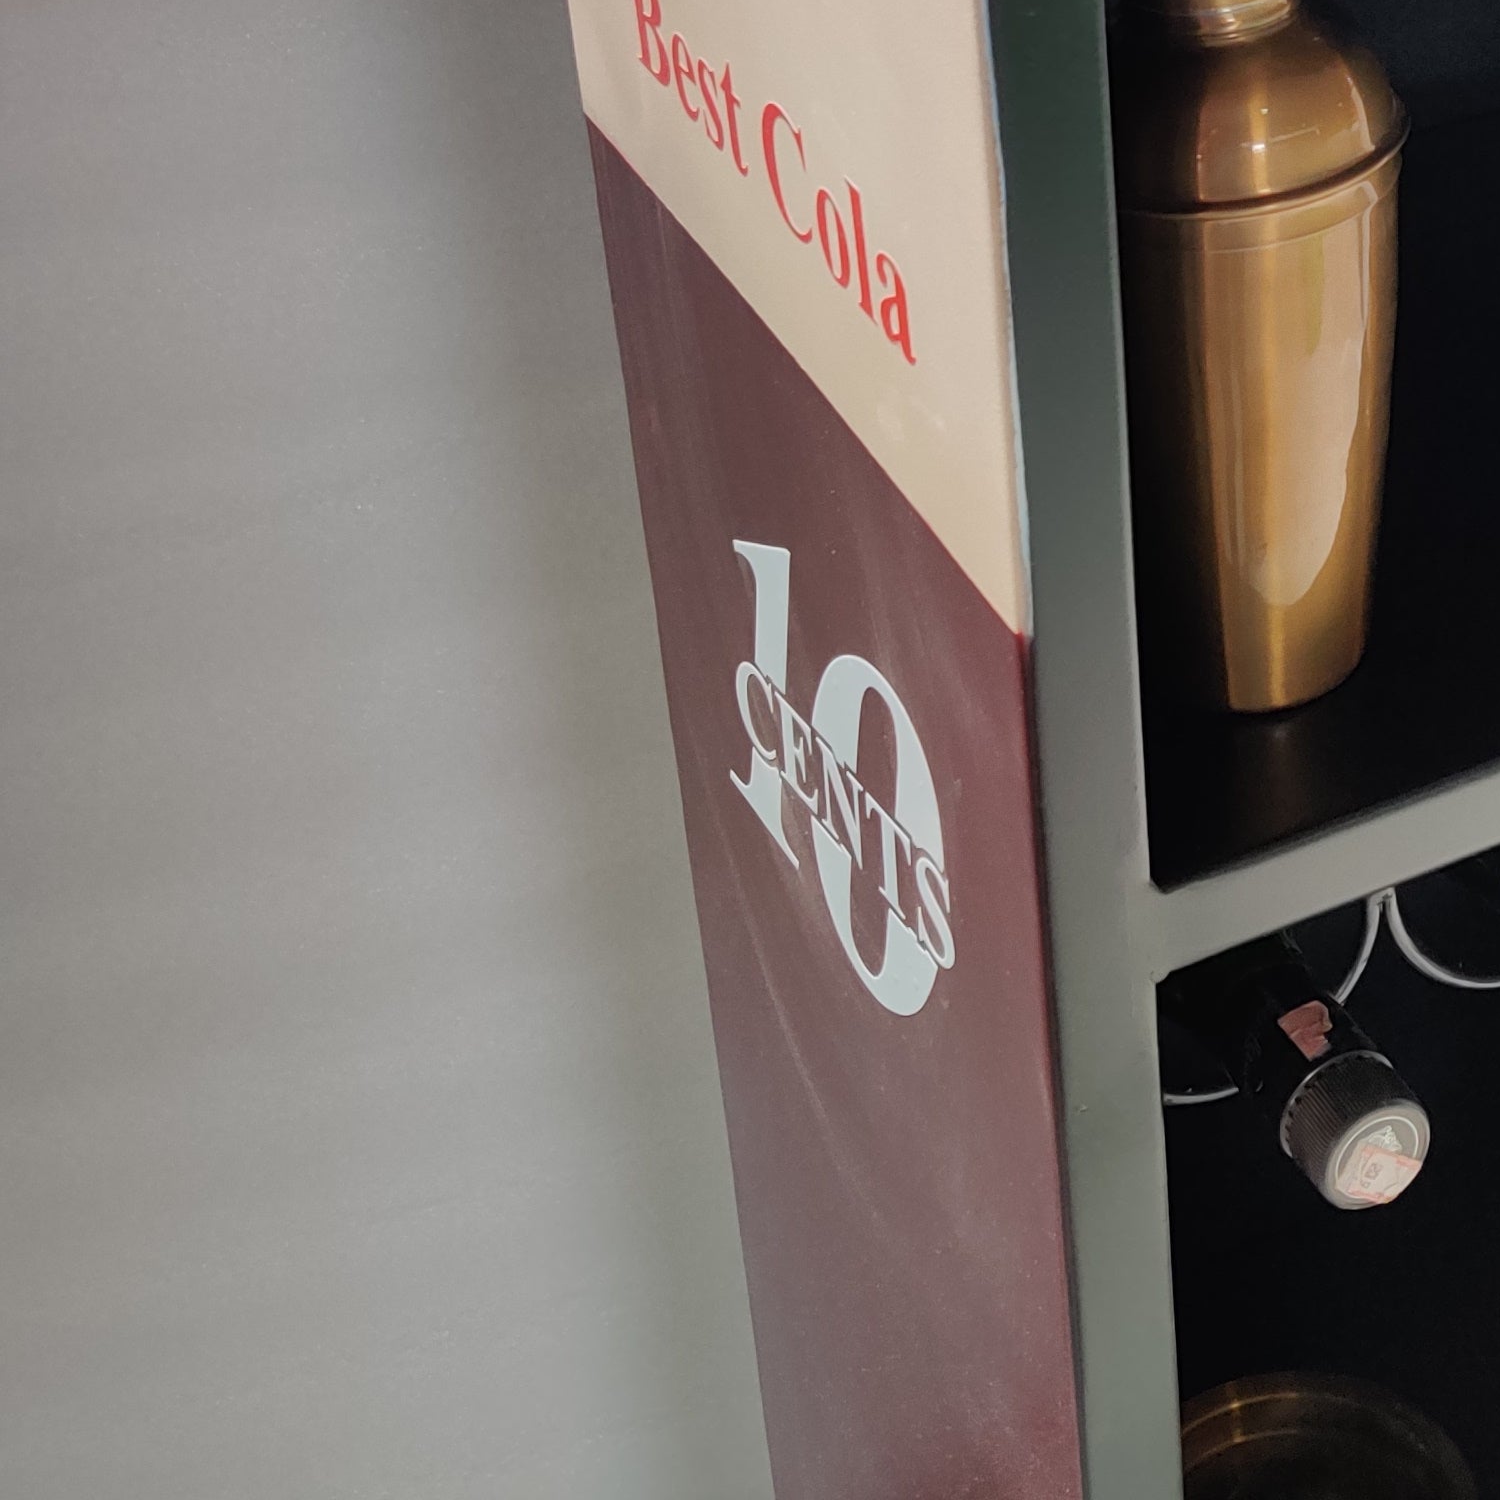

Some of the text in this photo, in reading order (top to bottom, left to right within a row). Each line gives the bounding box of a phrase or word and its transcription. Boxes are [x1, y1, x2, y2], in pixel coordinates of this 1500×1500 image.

[761, 100, 917, 366] Cola
[730, 539, 945, 1016] 10
[735, 660, 956, 970] CENTS
